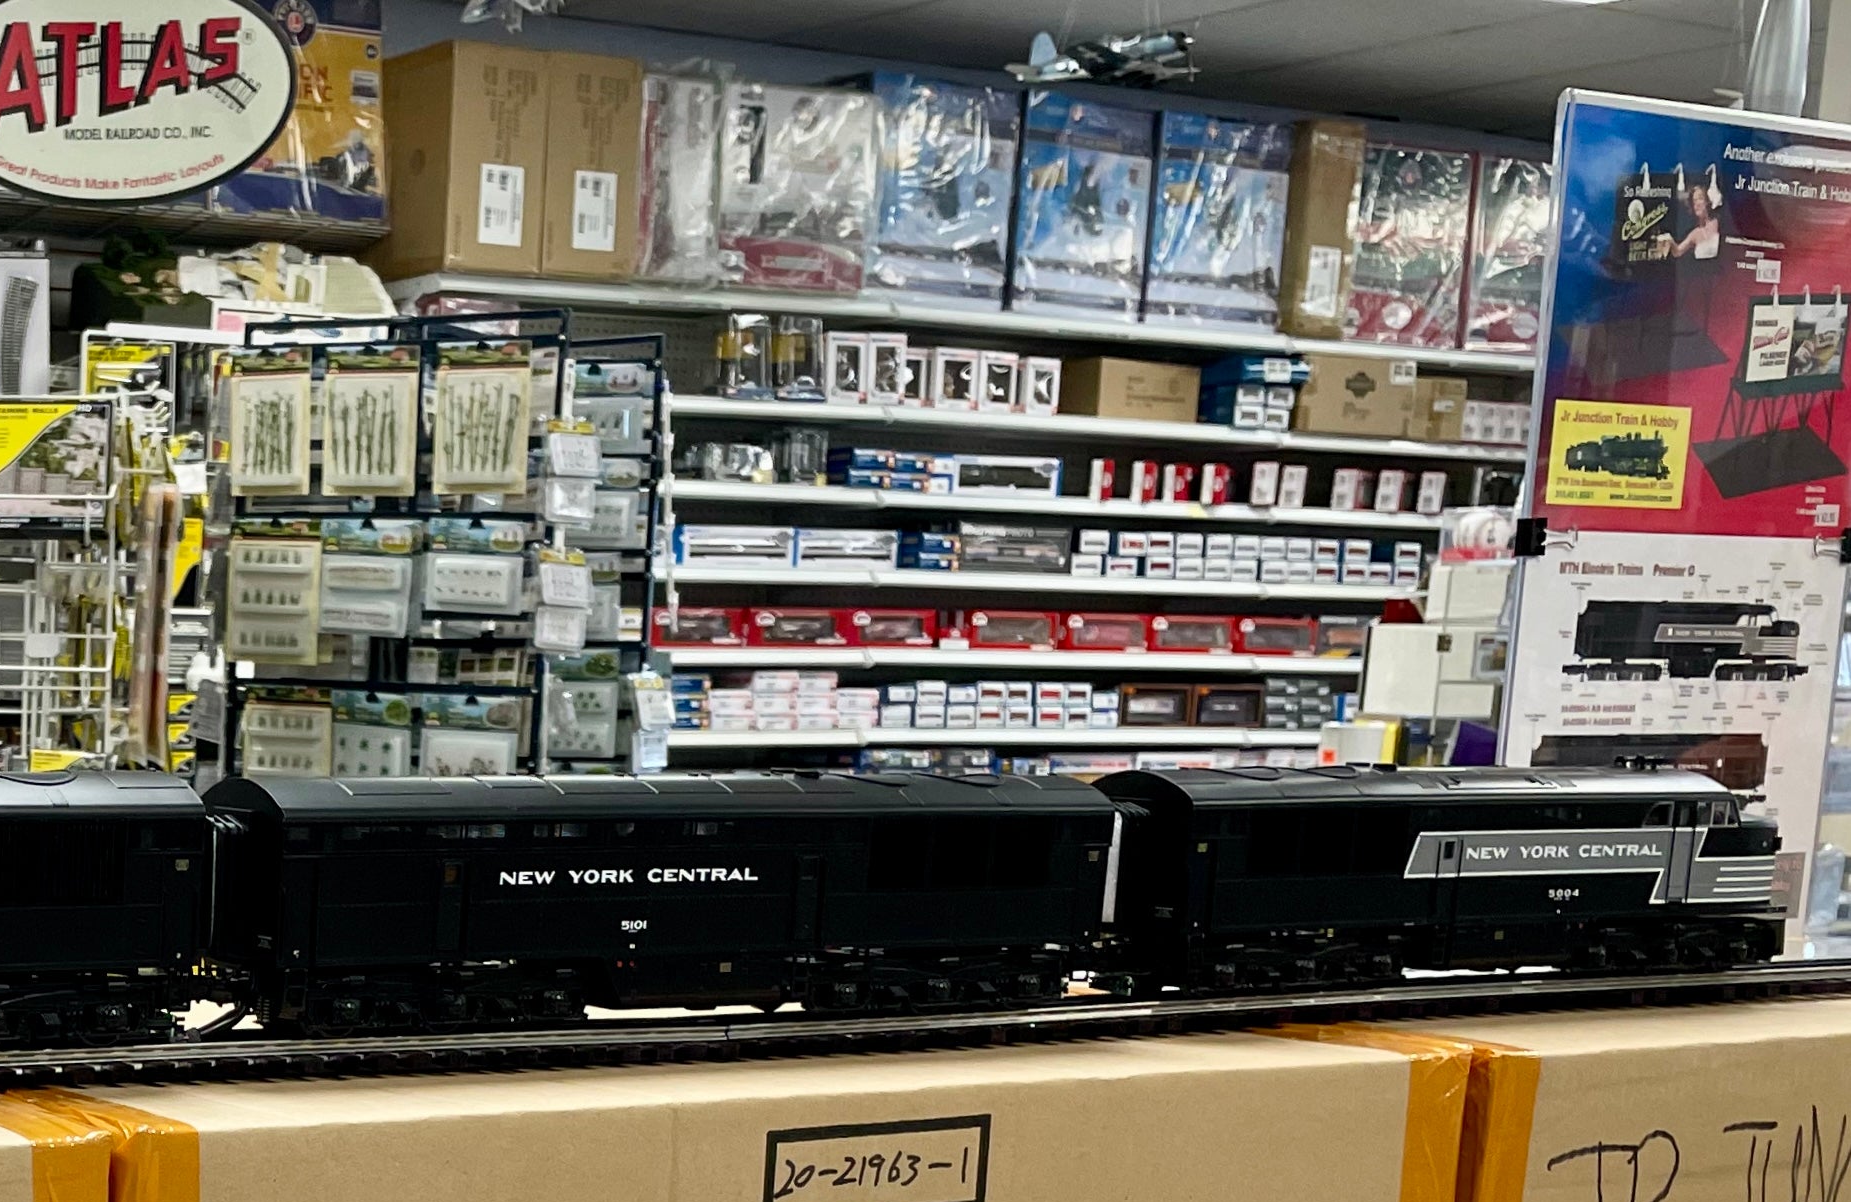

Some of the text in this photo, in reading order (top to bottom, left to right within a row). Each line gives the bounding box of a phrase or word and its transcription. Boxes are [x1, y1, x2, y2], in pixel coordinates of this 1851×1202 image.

[64, 127, 159, 140] MODEL RAILROAD
[31, 167, 82, 188] Products
[85, 176, 120, 191] Make
[123, 172, 177, 190] Fantastic
[180, 154, 225, 182] Layouts
[1735, 174, 1817, 199] Jr Junction Train
[1573, 411, 1679, 430] Junction Train Hobby
[1466, 843, 1662, 861] NEW YORK CENTRAL
[499, 867, 759, 886] NEW YORK CENTRAL
[620, 920, 647, 931] 5101
[773, 1146, 969, 1200] 20-21963-1
